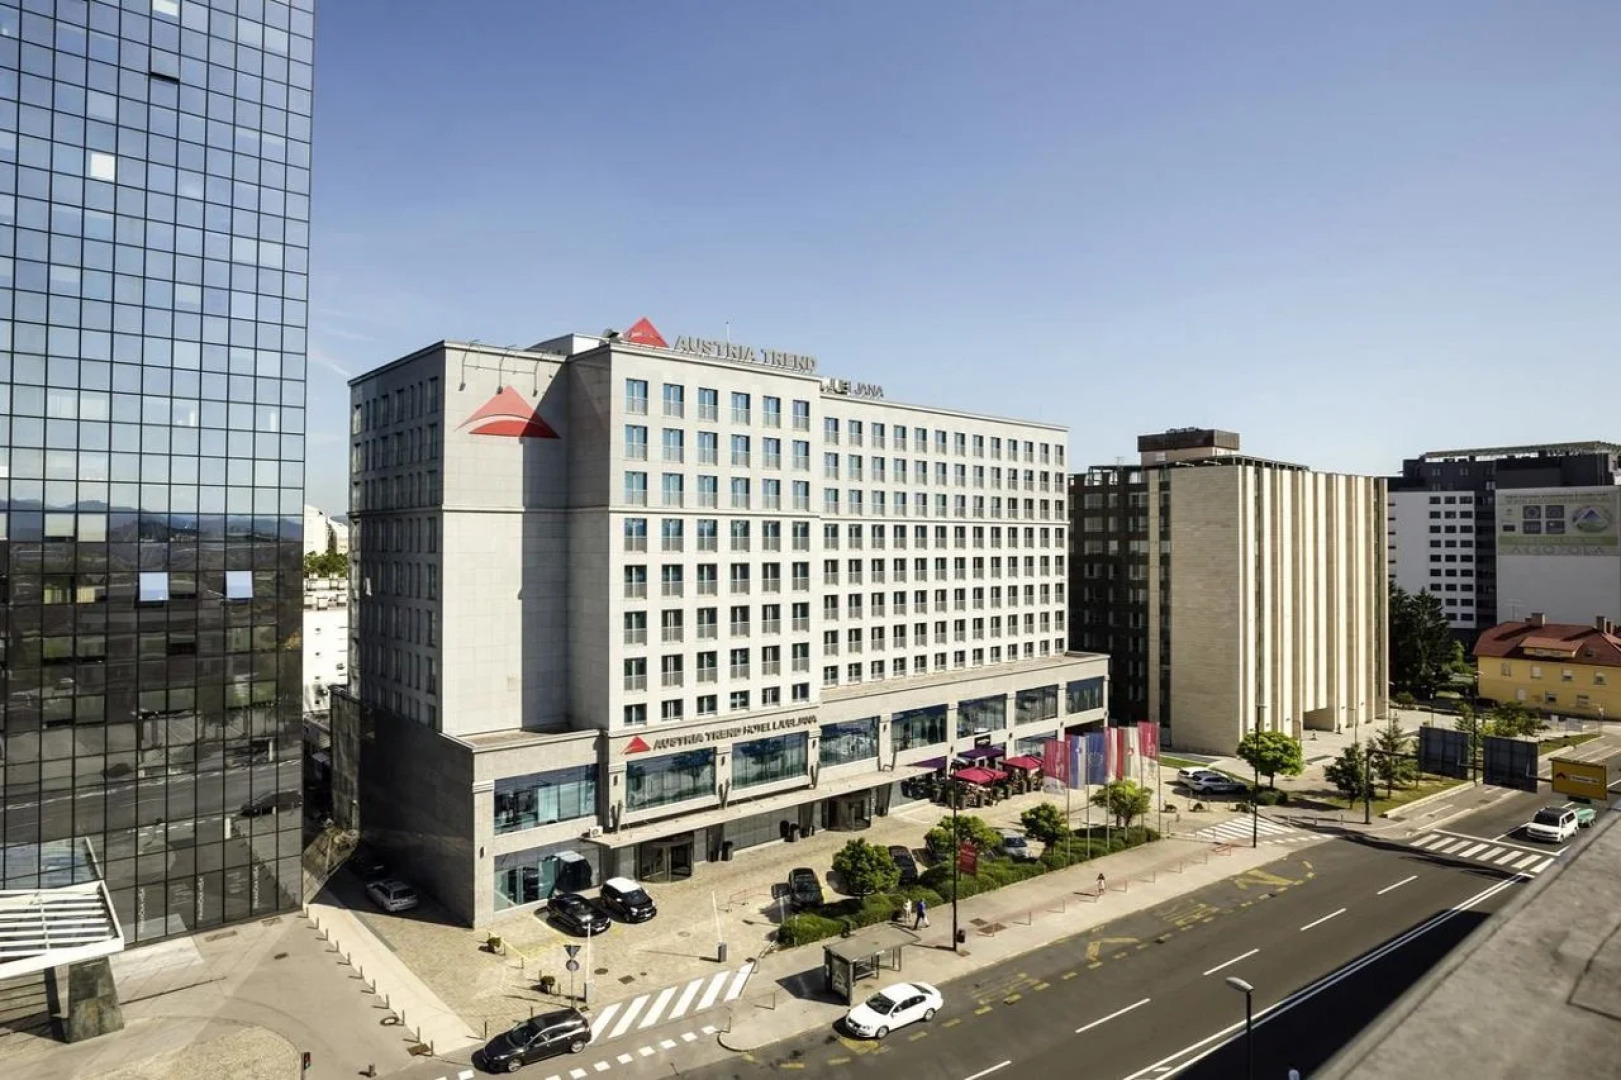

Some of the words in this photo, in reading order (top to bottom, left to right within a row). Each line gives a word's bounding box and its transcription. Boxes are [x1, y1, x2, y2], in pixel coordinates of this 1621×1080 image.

[673, 335, 755, 363] AUSTRIA
[761, 348, 817, 372] TREND
[653, 732, 704, 750] AUSTRIA
[705, 726, 741, 742] TREND
